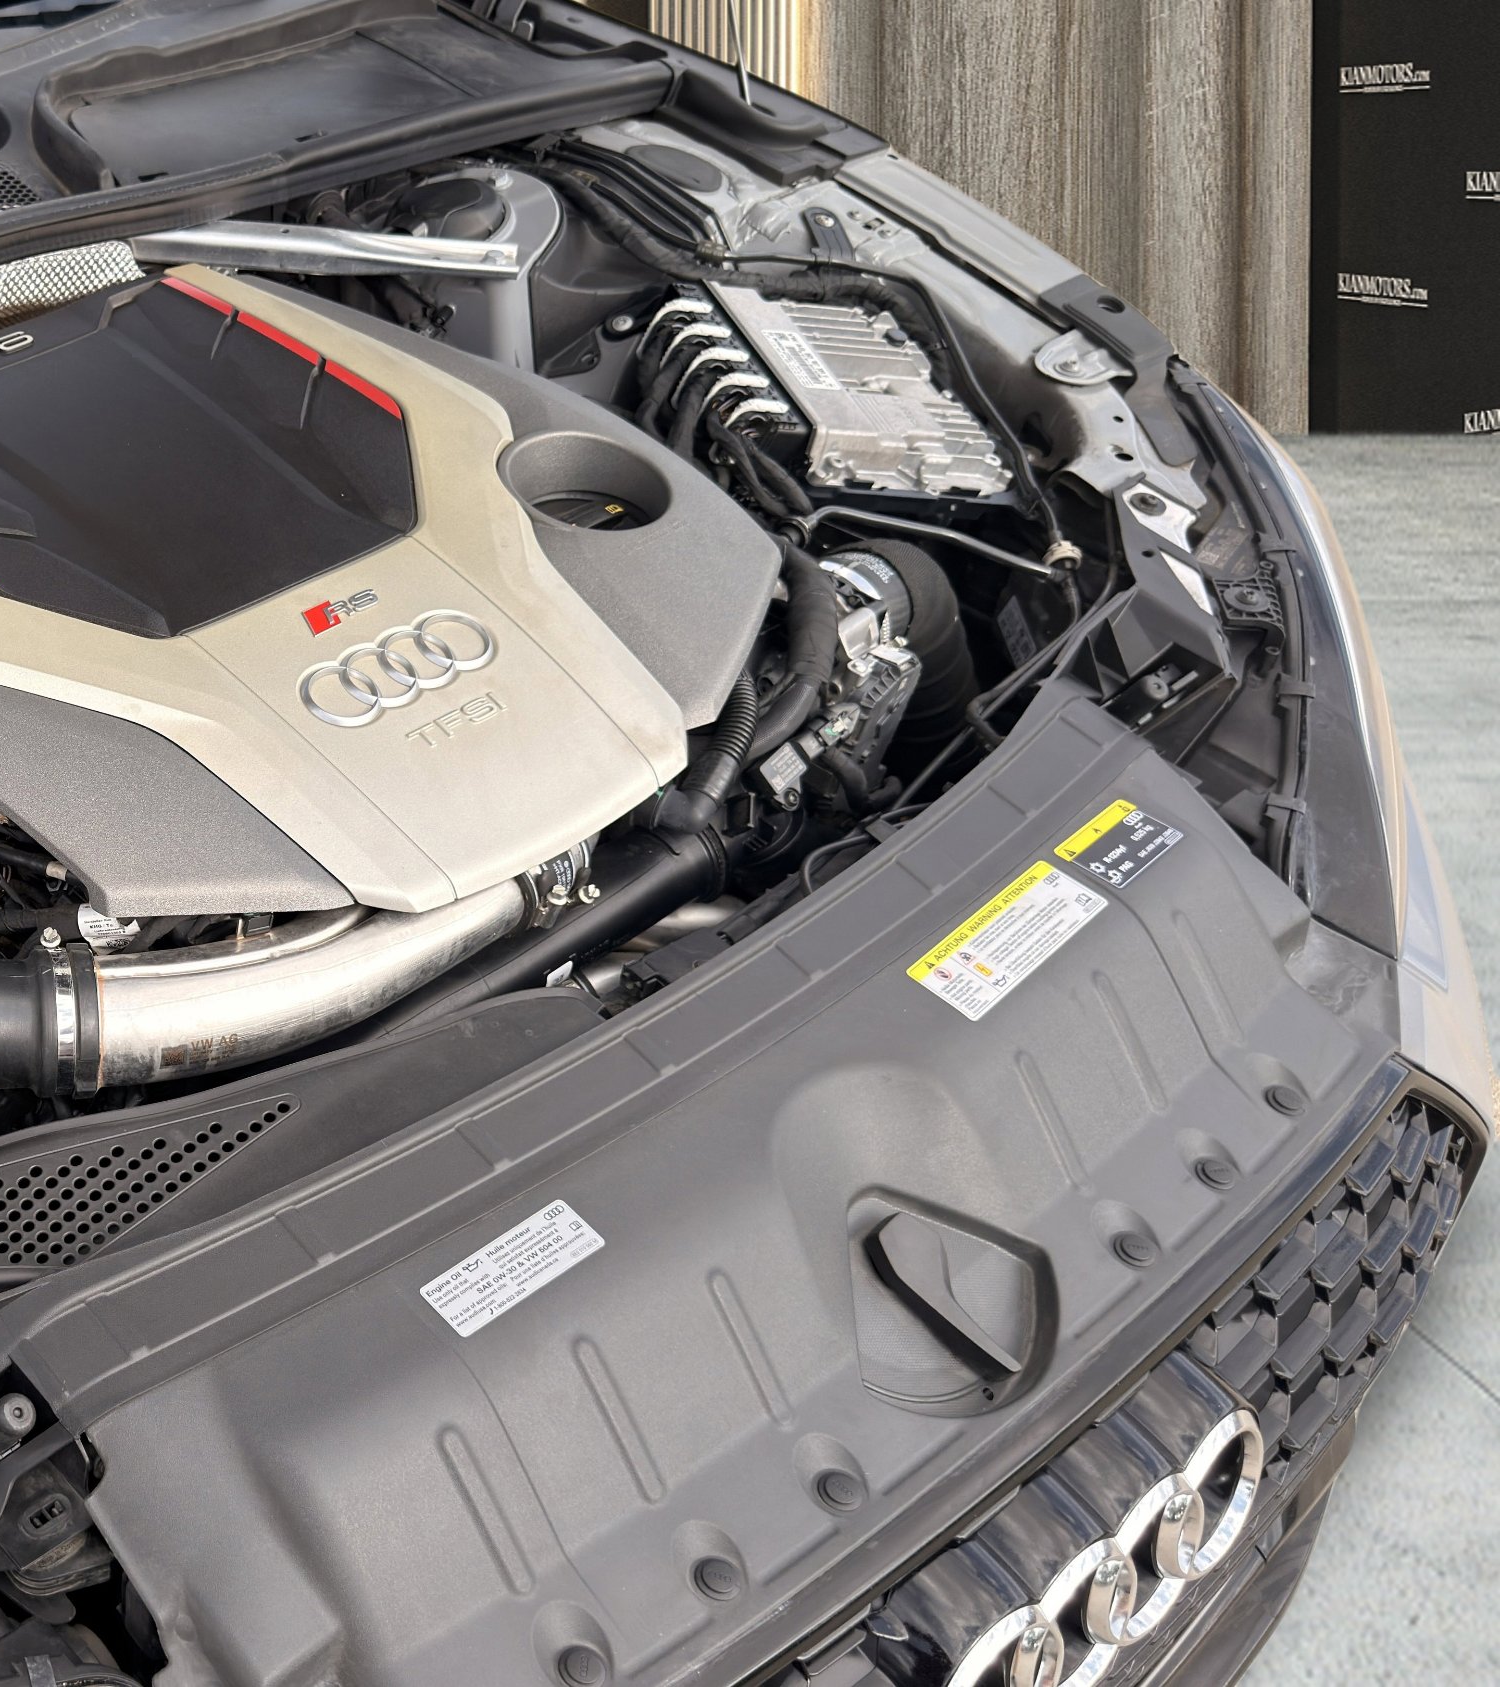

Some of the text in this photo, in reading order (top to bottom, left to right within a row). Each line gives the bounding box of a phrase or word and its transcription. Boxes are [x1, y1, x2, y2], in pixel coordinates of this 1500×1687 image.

[320, 588, 380, 626] RS
[404, 691, 508, 748] TFSI
[933, 932, 969, 961] ACHTUNG
[967, 904, 1002, 933] WARNING
[1001, 874, 1038, 905] ATTENTION
[190, 1033, 239, 1051] VW AG
[485, 1226, 531, 1257] Huile moteur
[476, 1281, 493, 1294] SAE
[492, 1265, 517, 1283] 0W-30
[524, 1251, 539, 1262] VW
[552, 1235, 563, 1244] 00
[426, 1271, 462, 1297] Engine Oil
[432, 1295, 443, 1304] Use
[442, 1289, 454, 1298] only
[450, 1314, 460, 1322] For
